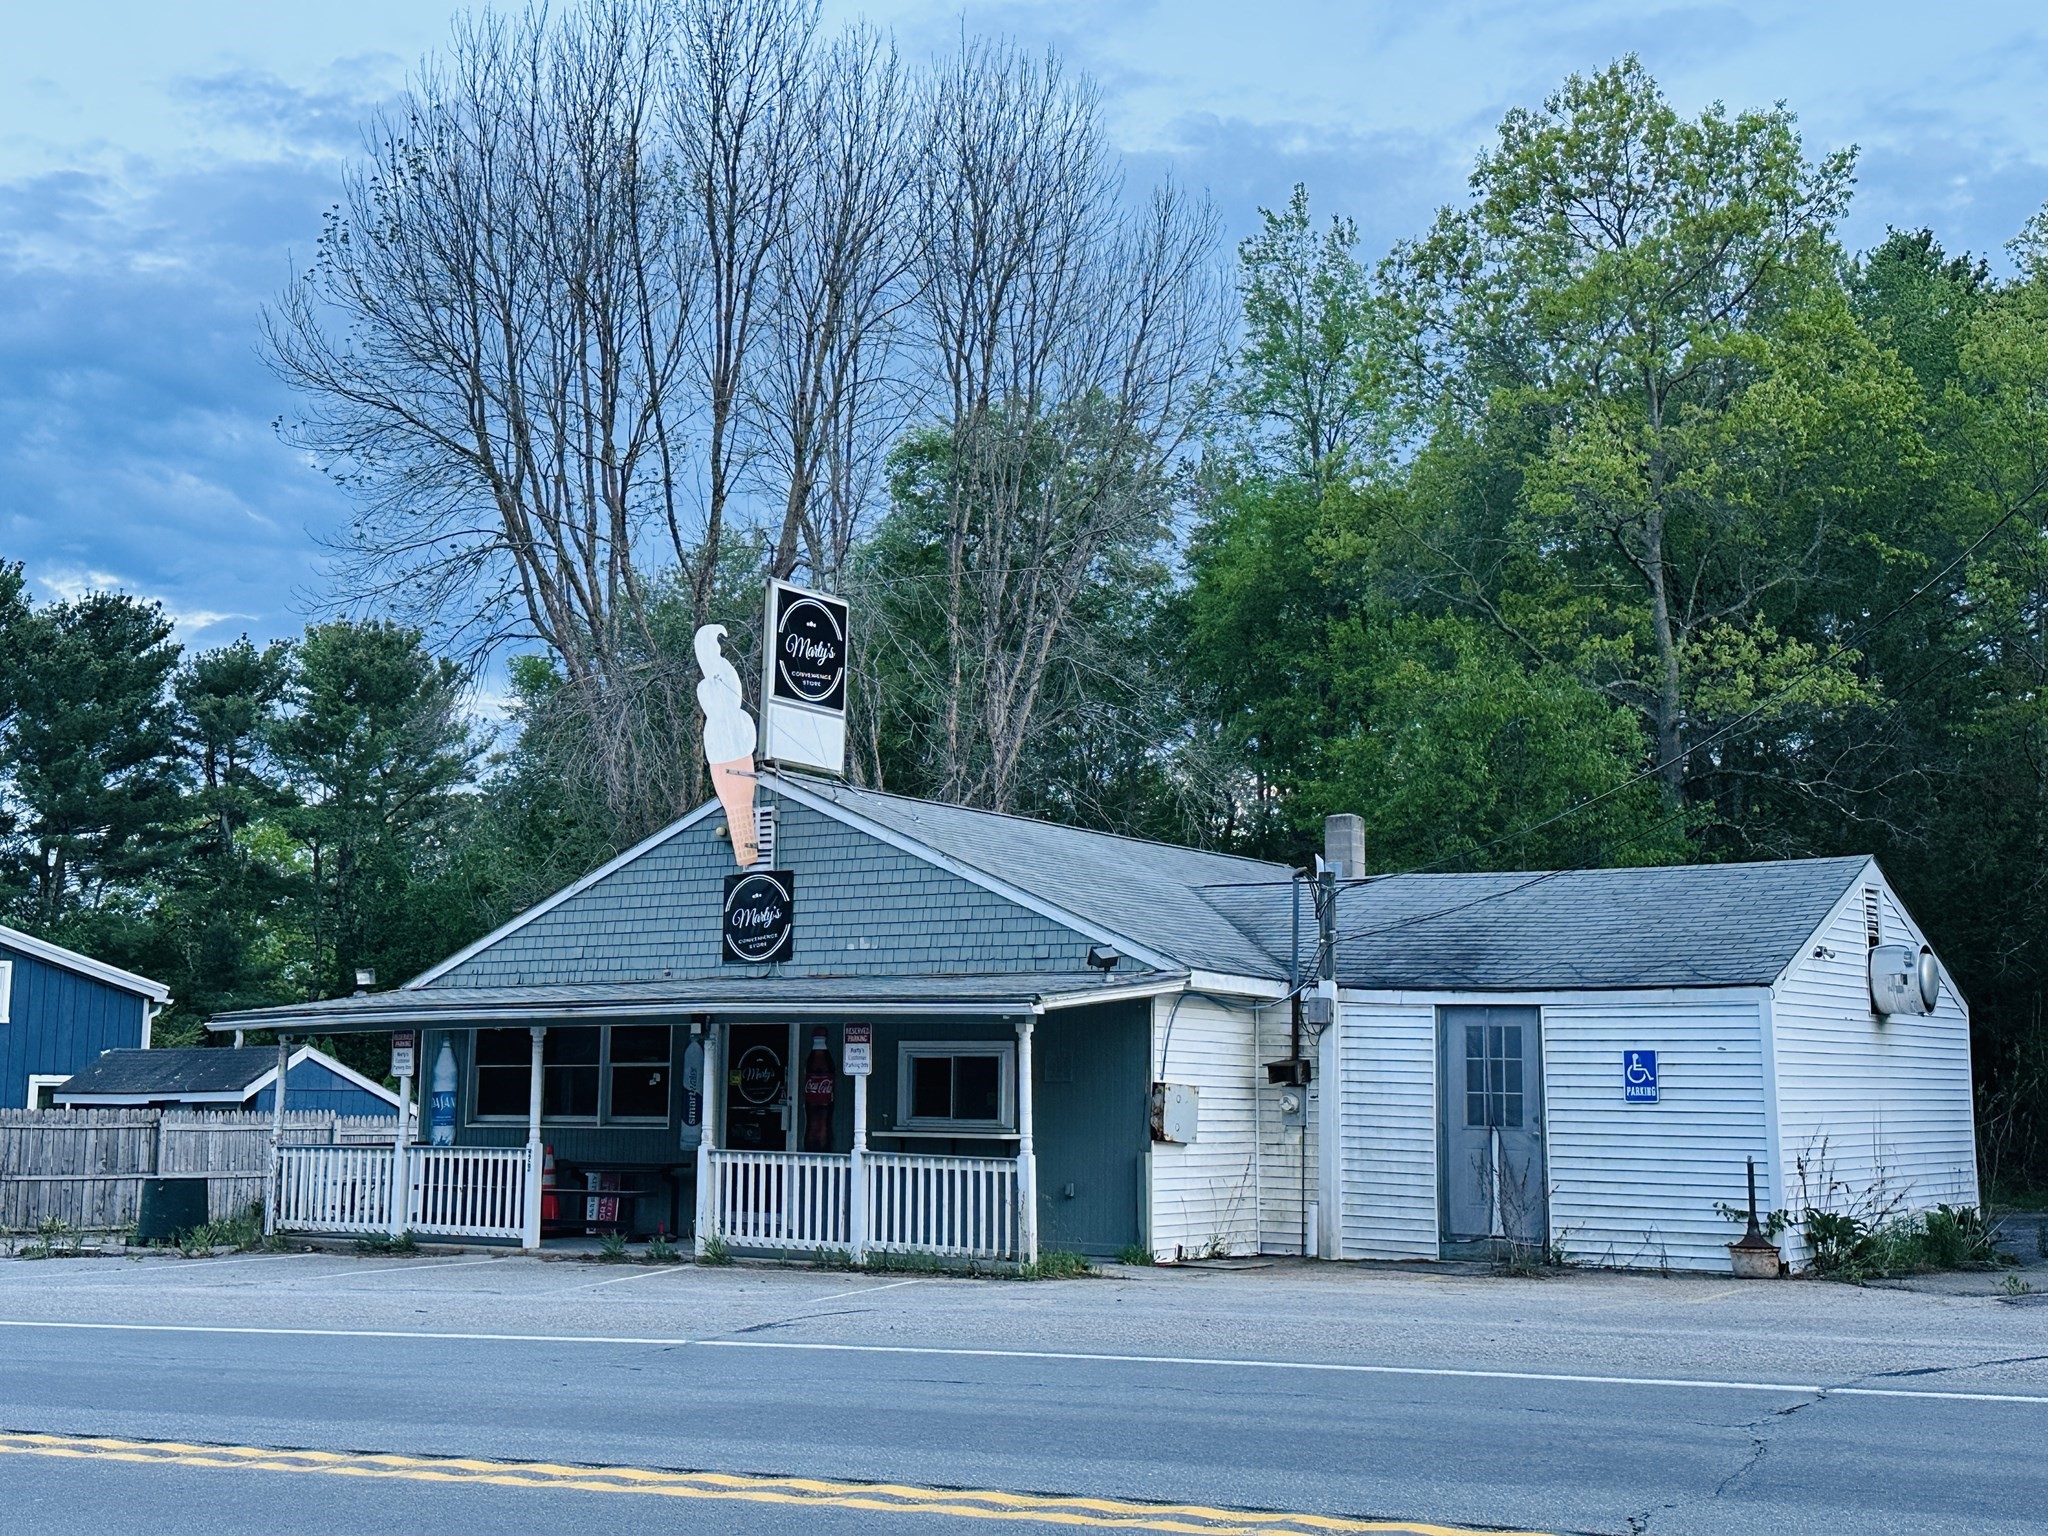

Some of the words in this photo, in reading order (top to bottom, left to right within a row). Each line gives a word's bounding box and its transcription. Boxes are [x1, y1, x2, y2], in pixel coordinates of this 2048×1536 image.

[785, 633, 836, 665] Marty's
[791, 670, 832, 681] CONVENIENCE
[802, 679, 821, 687] STORE
[732, 905, 782, 929] Marty's
[738, 932, 778, 944] CONVENIENCE
[749, 941, 767, 949] STORE
[1626, 1086, 1656, 1097] PARKING
